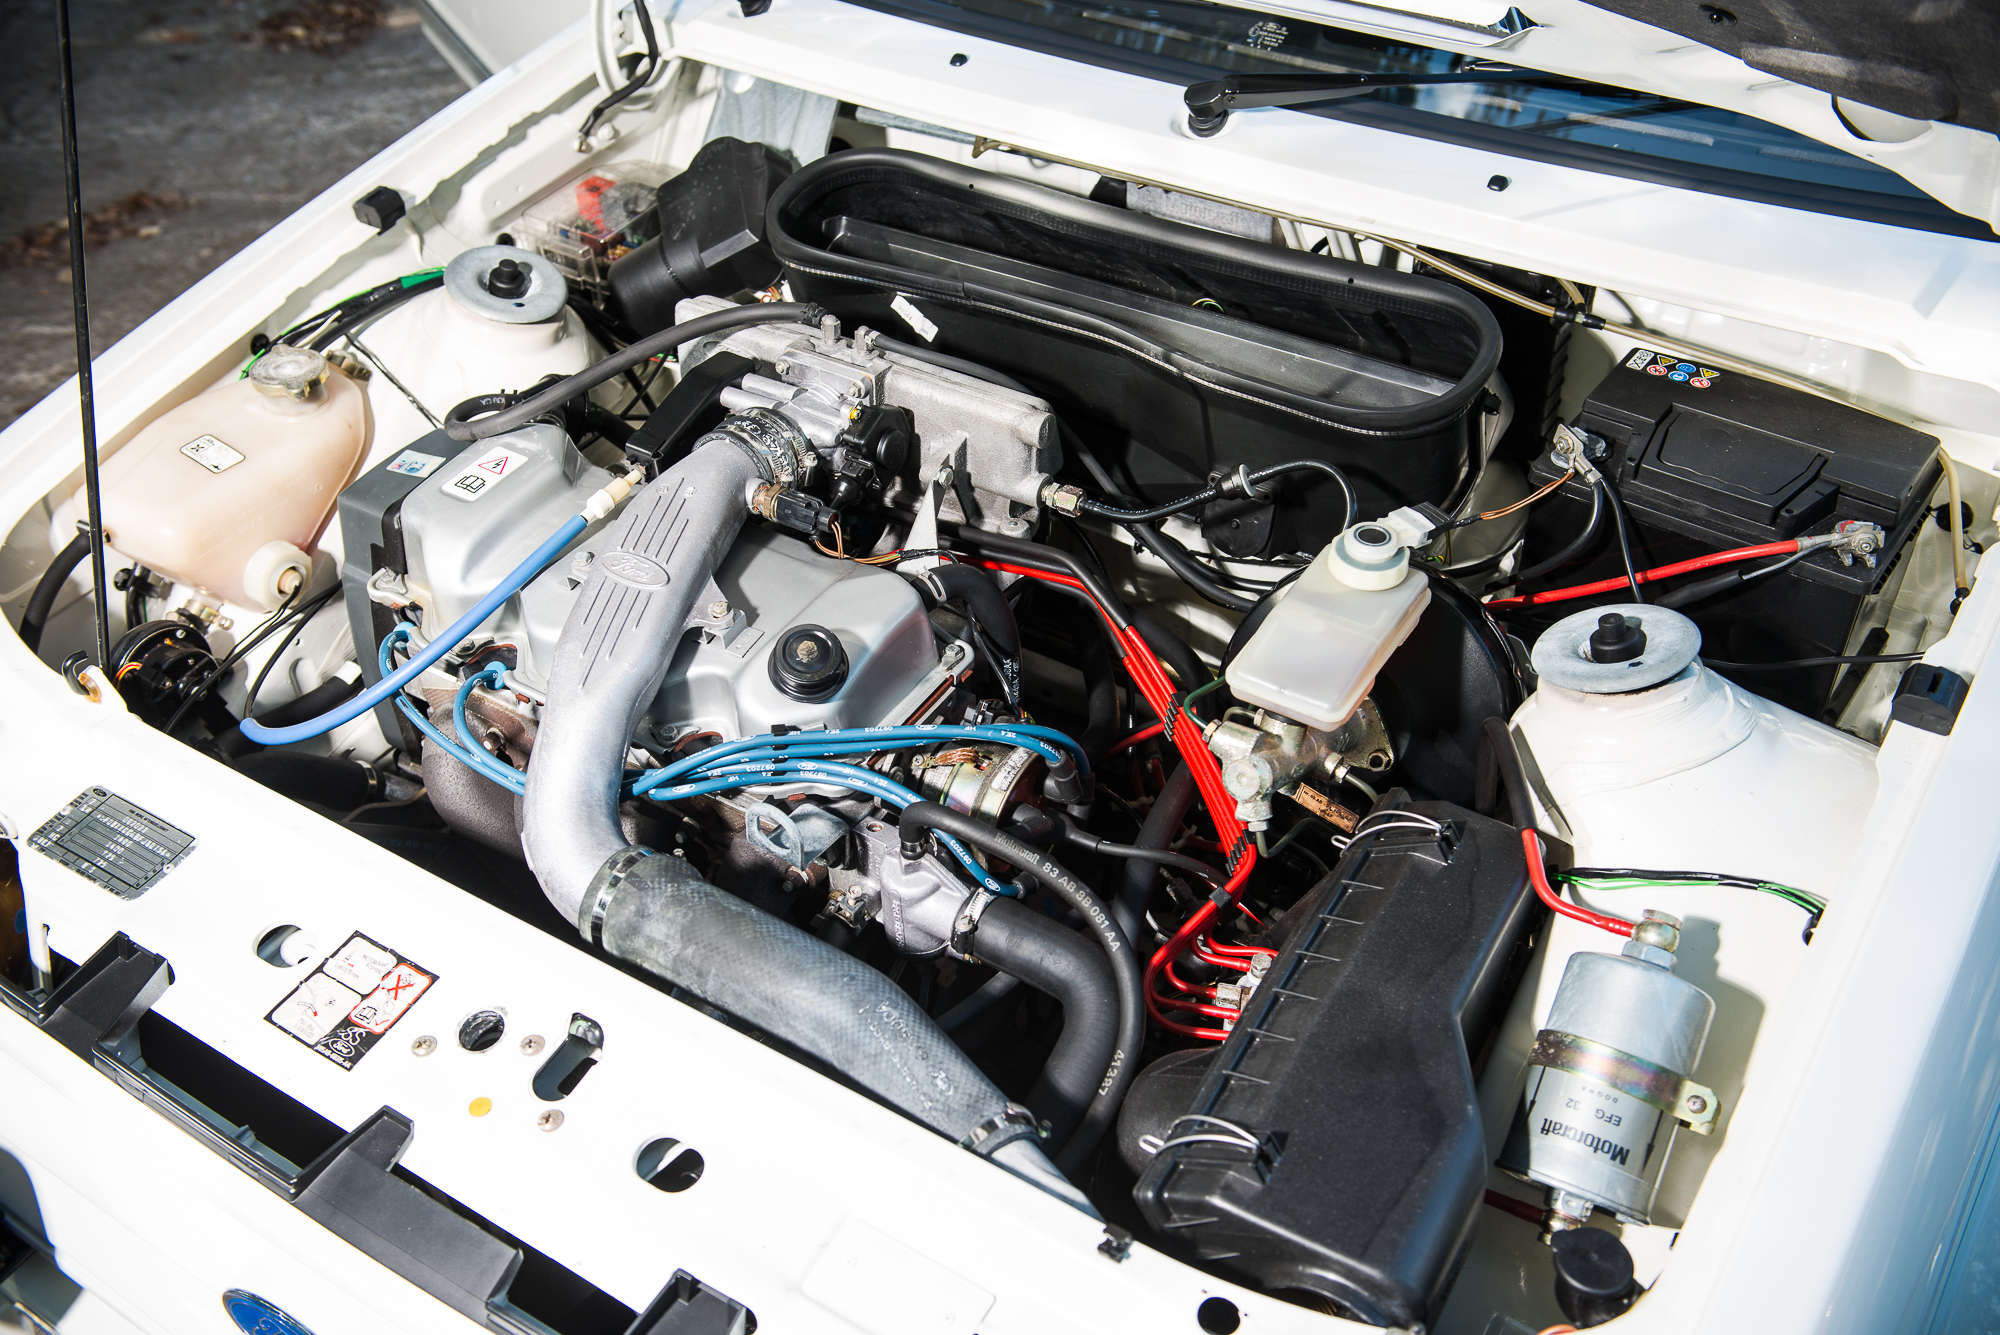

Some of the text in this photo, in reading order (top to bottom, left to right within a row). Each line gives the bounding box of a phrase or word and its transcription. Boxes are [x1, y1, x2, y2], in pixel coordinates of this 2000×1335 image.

[950, 839, 973, 865] 097203
[994, 832, 1121, 952] Motorcraft 83 AB 8B 081 AA
[1098, 1049, 1125, 1096] 41387
[1594, 1108, 1622, 1127] EFG
[1540, 1117, 1630, 1166] Motorcraft
